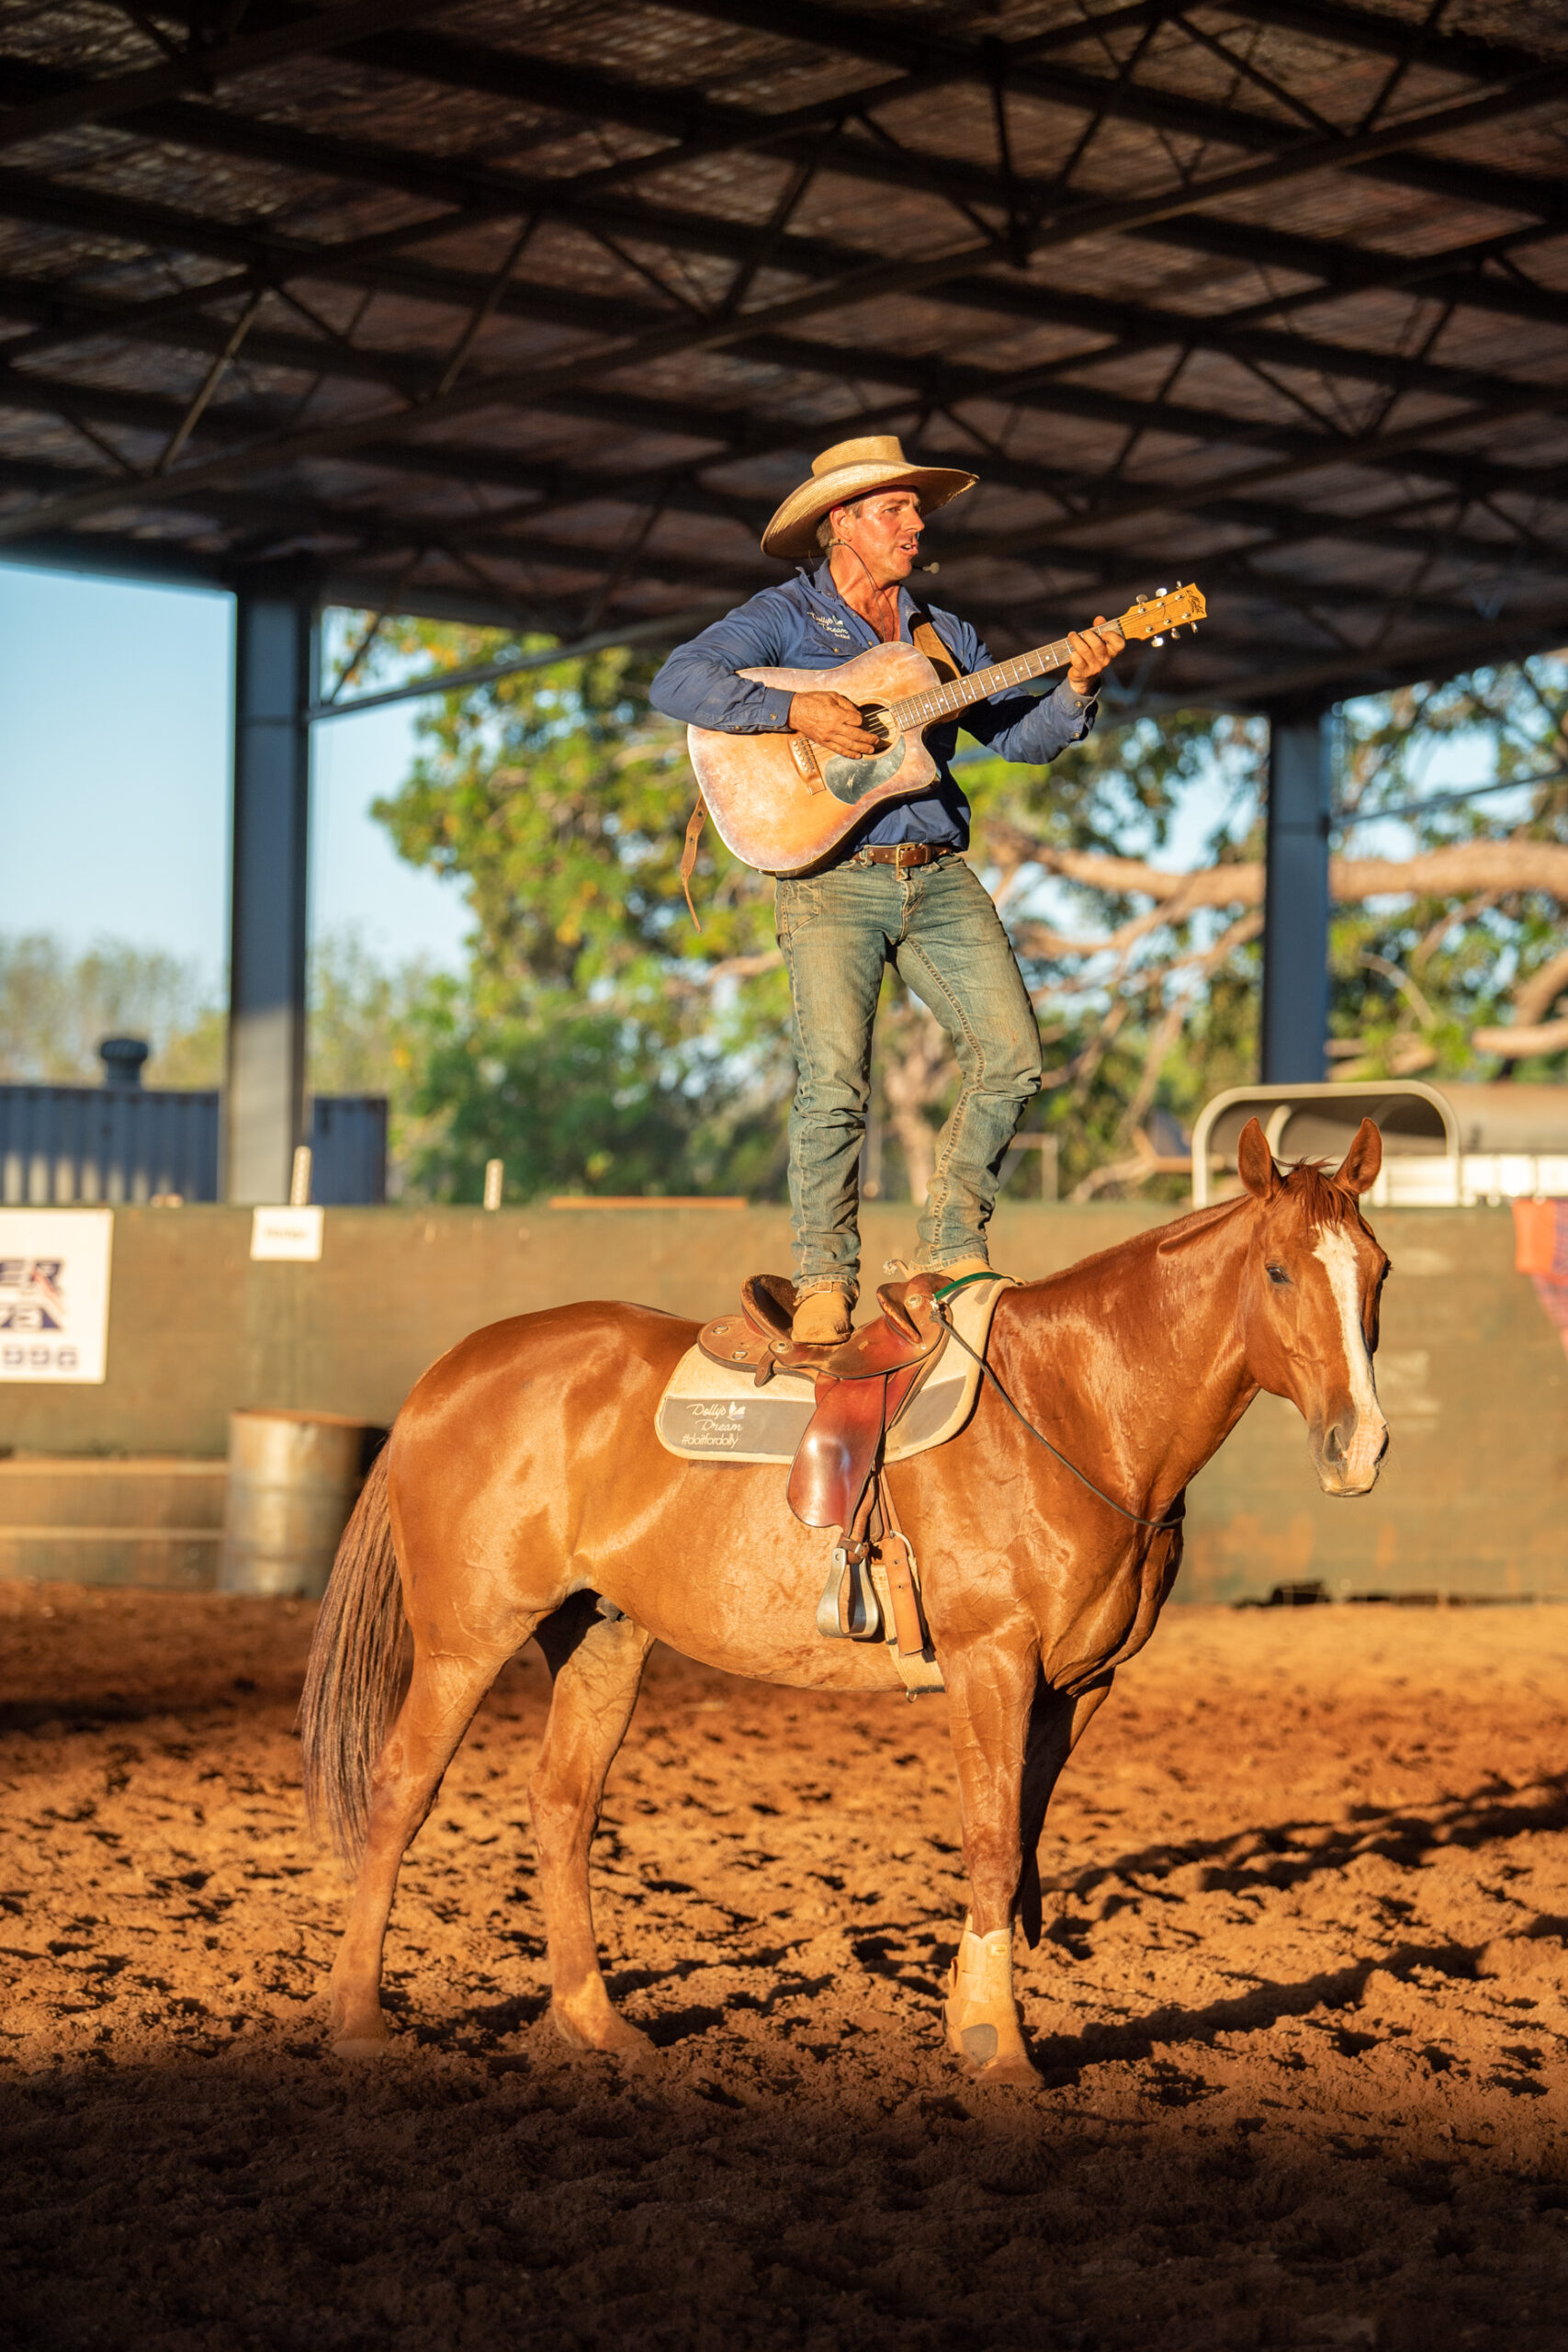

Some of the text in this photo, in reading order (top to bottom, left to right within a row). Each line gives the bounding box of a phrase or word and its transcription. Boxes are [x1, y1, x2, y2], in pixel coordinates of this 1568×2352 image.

[686, 1403, 727, 1419] Dolly's
[694, 1419, 743, 1431] Dream
[682, 1433, 739, 1449] #doitfordolly
